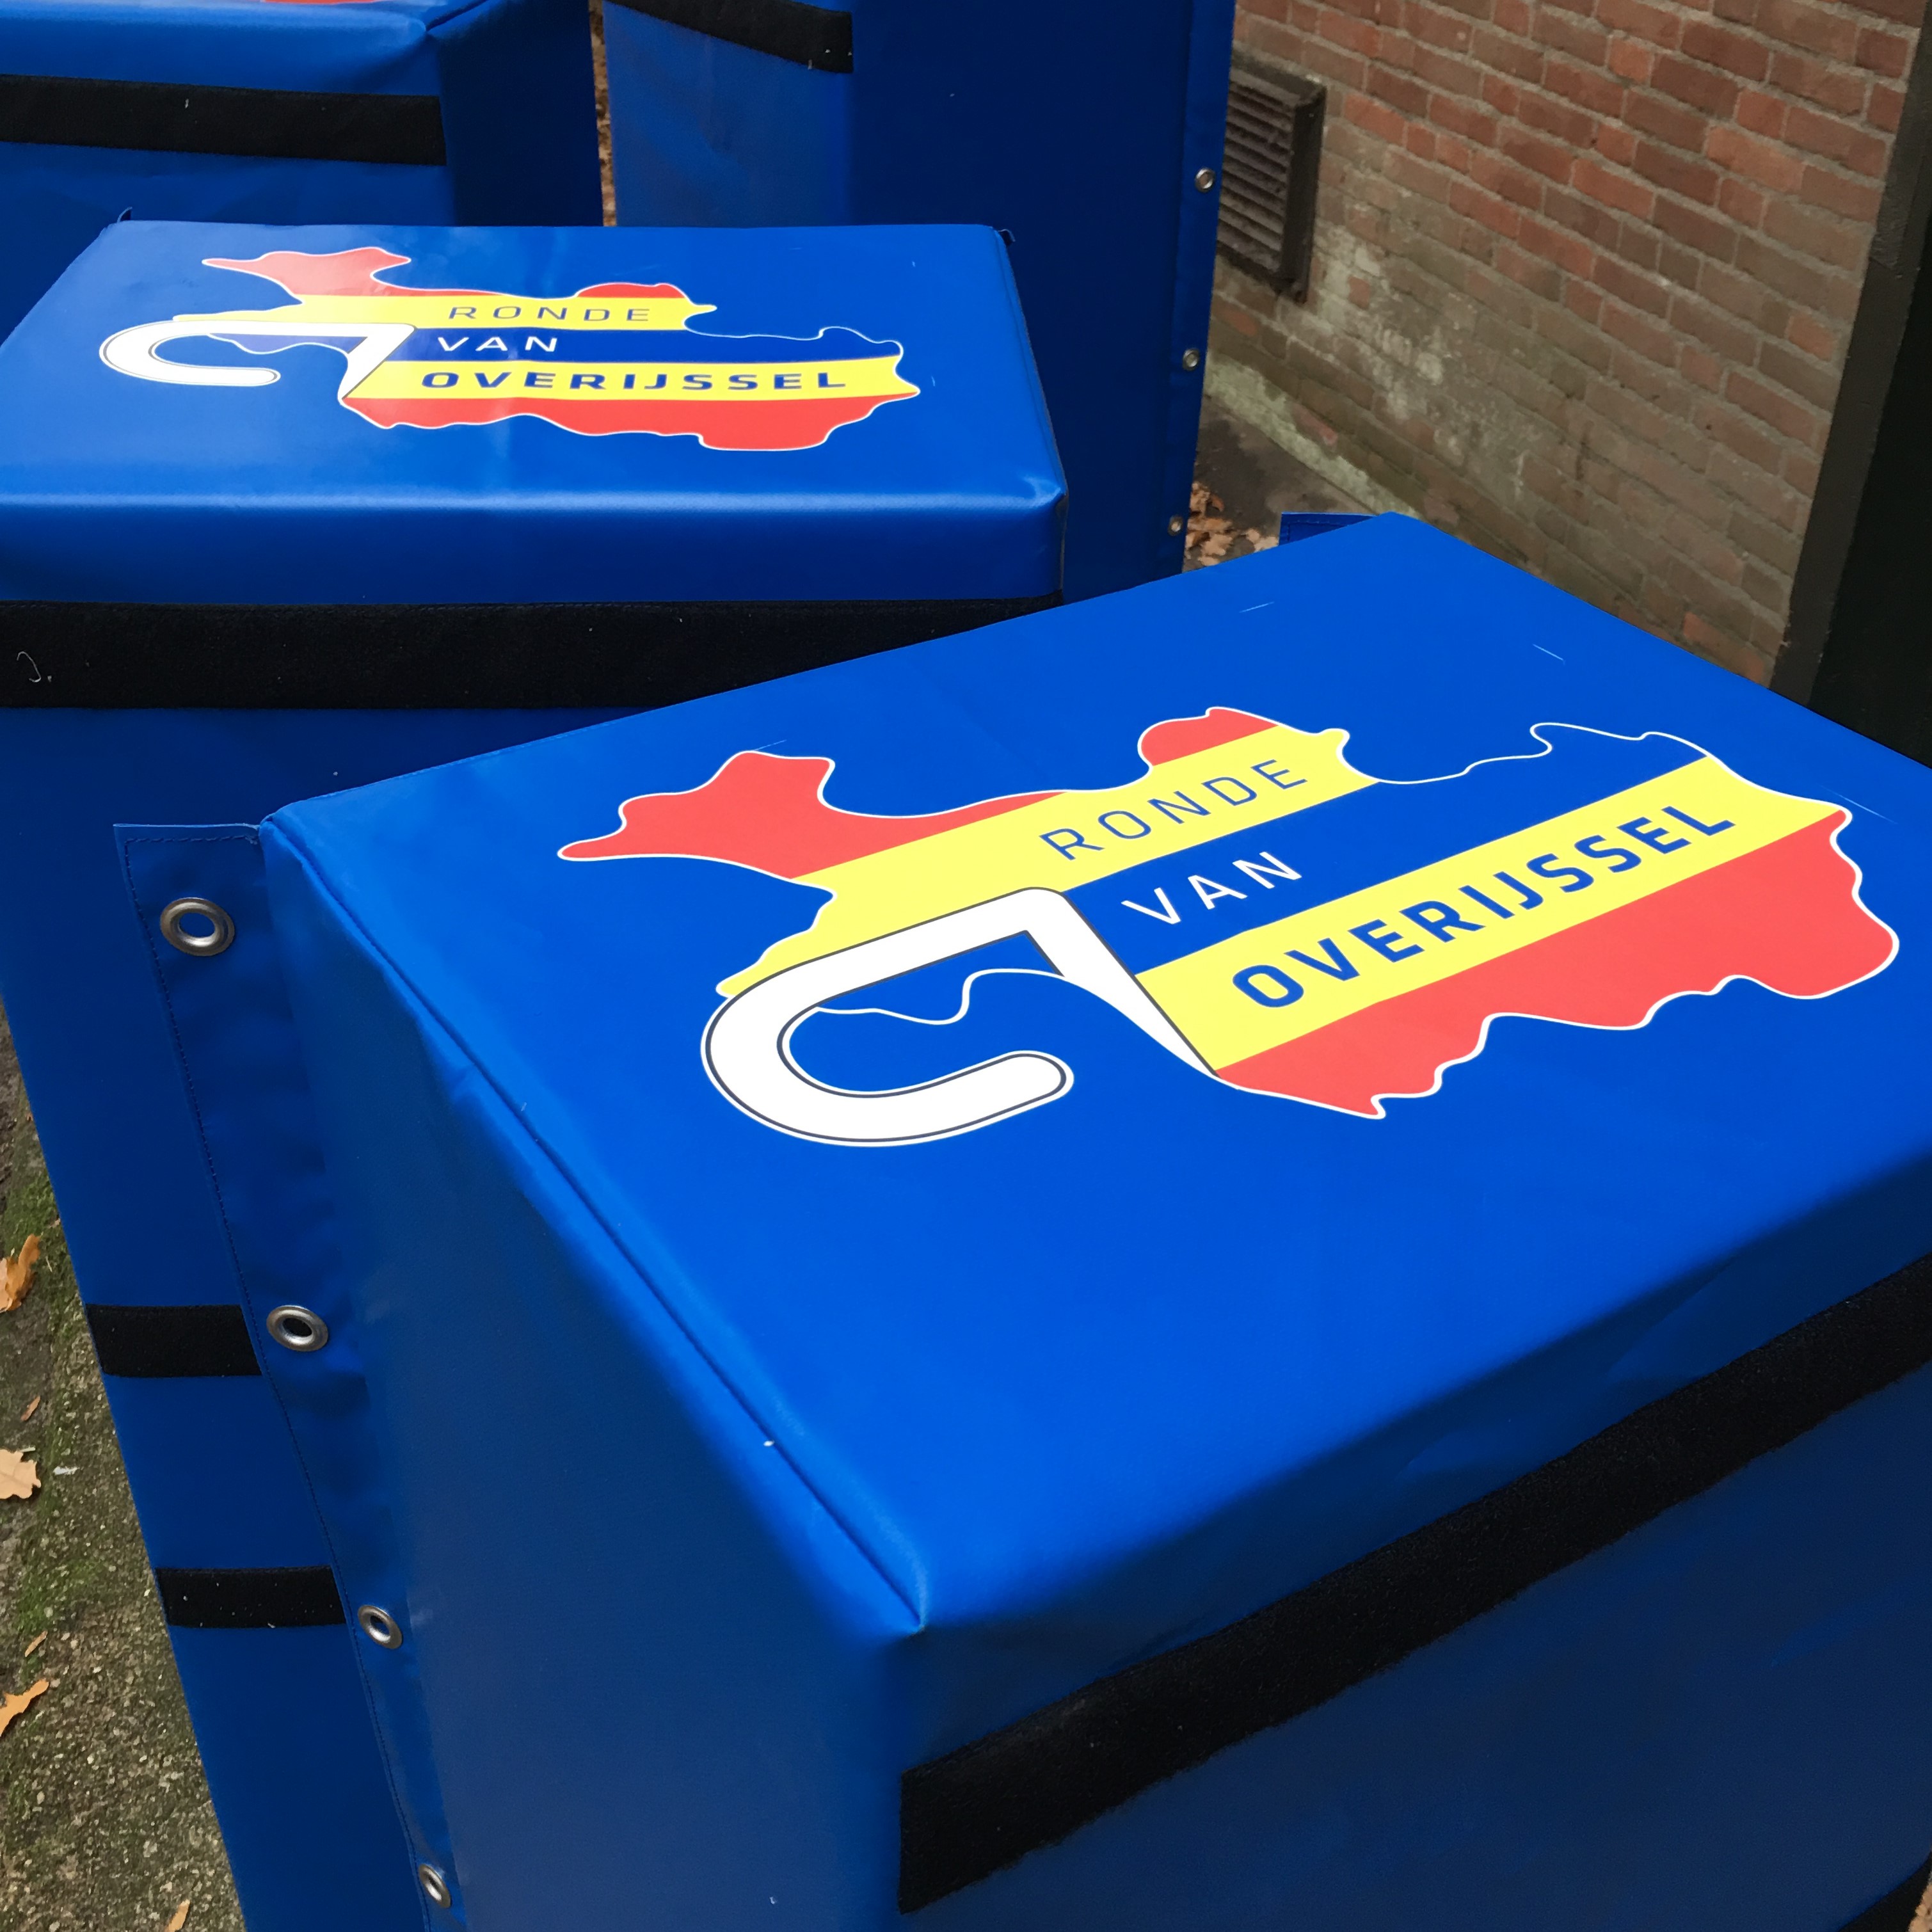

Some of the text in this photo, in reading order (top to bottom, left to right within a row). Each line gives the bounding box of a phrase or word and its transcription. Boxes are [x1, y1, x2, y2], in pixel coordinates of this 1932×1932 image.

[448, 305, 650, 323] RONDE
[436, 336, 557, 353] VAN
[421, 371, 847, 390] OVERIJSSEL
[1039, 759, 1309, 861] RONDE
[1121, 850, 1302, 926] VAN
[1231, 805, 1737, 1008] OVERIJSSEL
